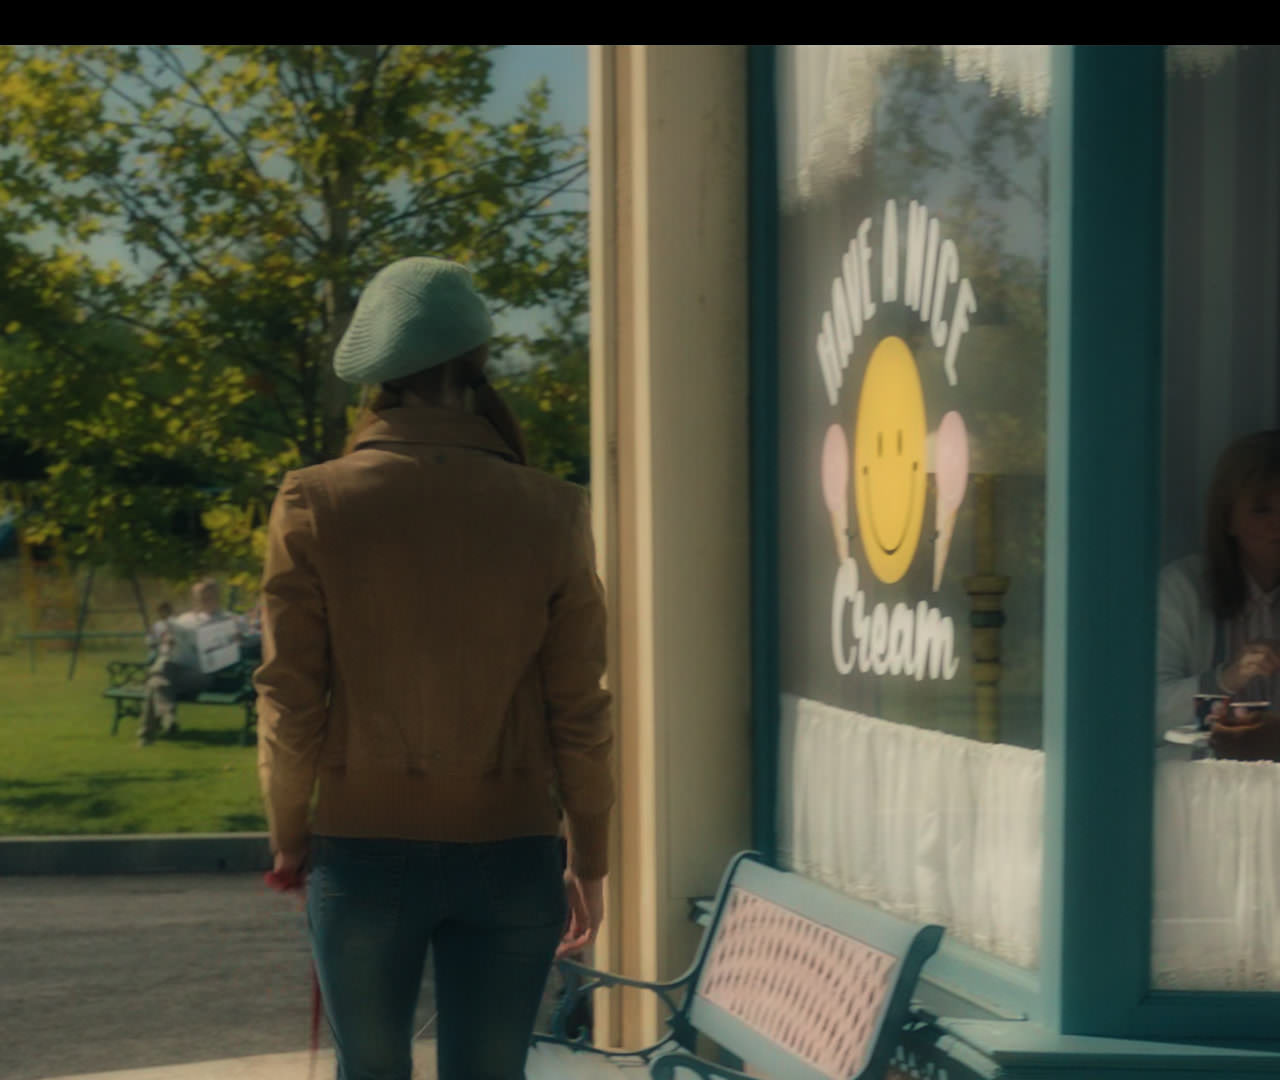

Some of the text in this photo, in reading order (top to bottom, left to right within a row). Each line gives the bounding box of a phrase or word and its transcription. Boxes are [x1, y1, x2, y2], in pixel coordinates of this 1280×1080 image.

[816, 198, 978, 406] HAVE A NICE
[832, 557, 960, 681] Cream
